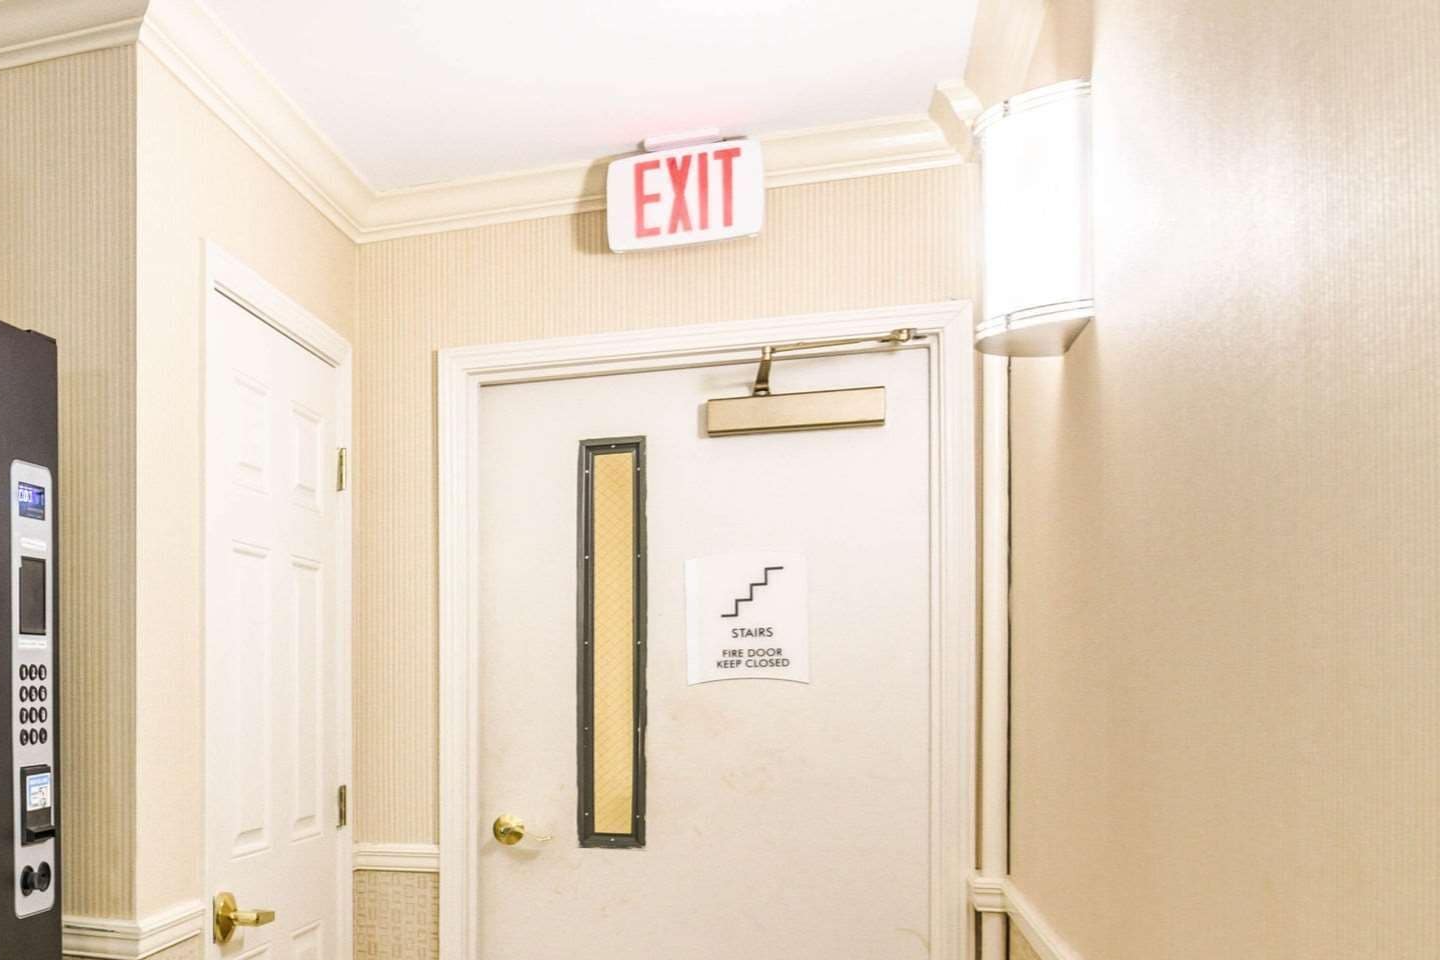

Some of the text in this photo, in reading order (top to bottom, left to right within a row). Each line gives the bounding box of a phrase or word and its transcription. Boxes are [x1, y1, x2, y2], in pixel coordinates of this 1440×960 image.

[633, 147, 741, 238] EXIT
[731, 627, 774, 639] STAIRS
[722, 647, 783, 658] FIRE DOOR
[716, 658, 790, 669] KEEP CLOSED
